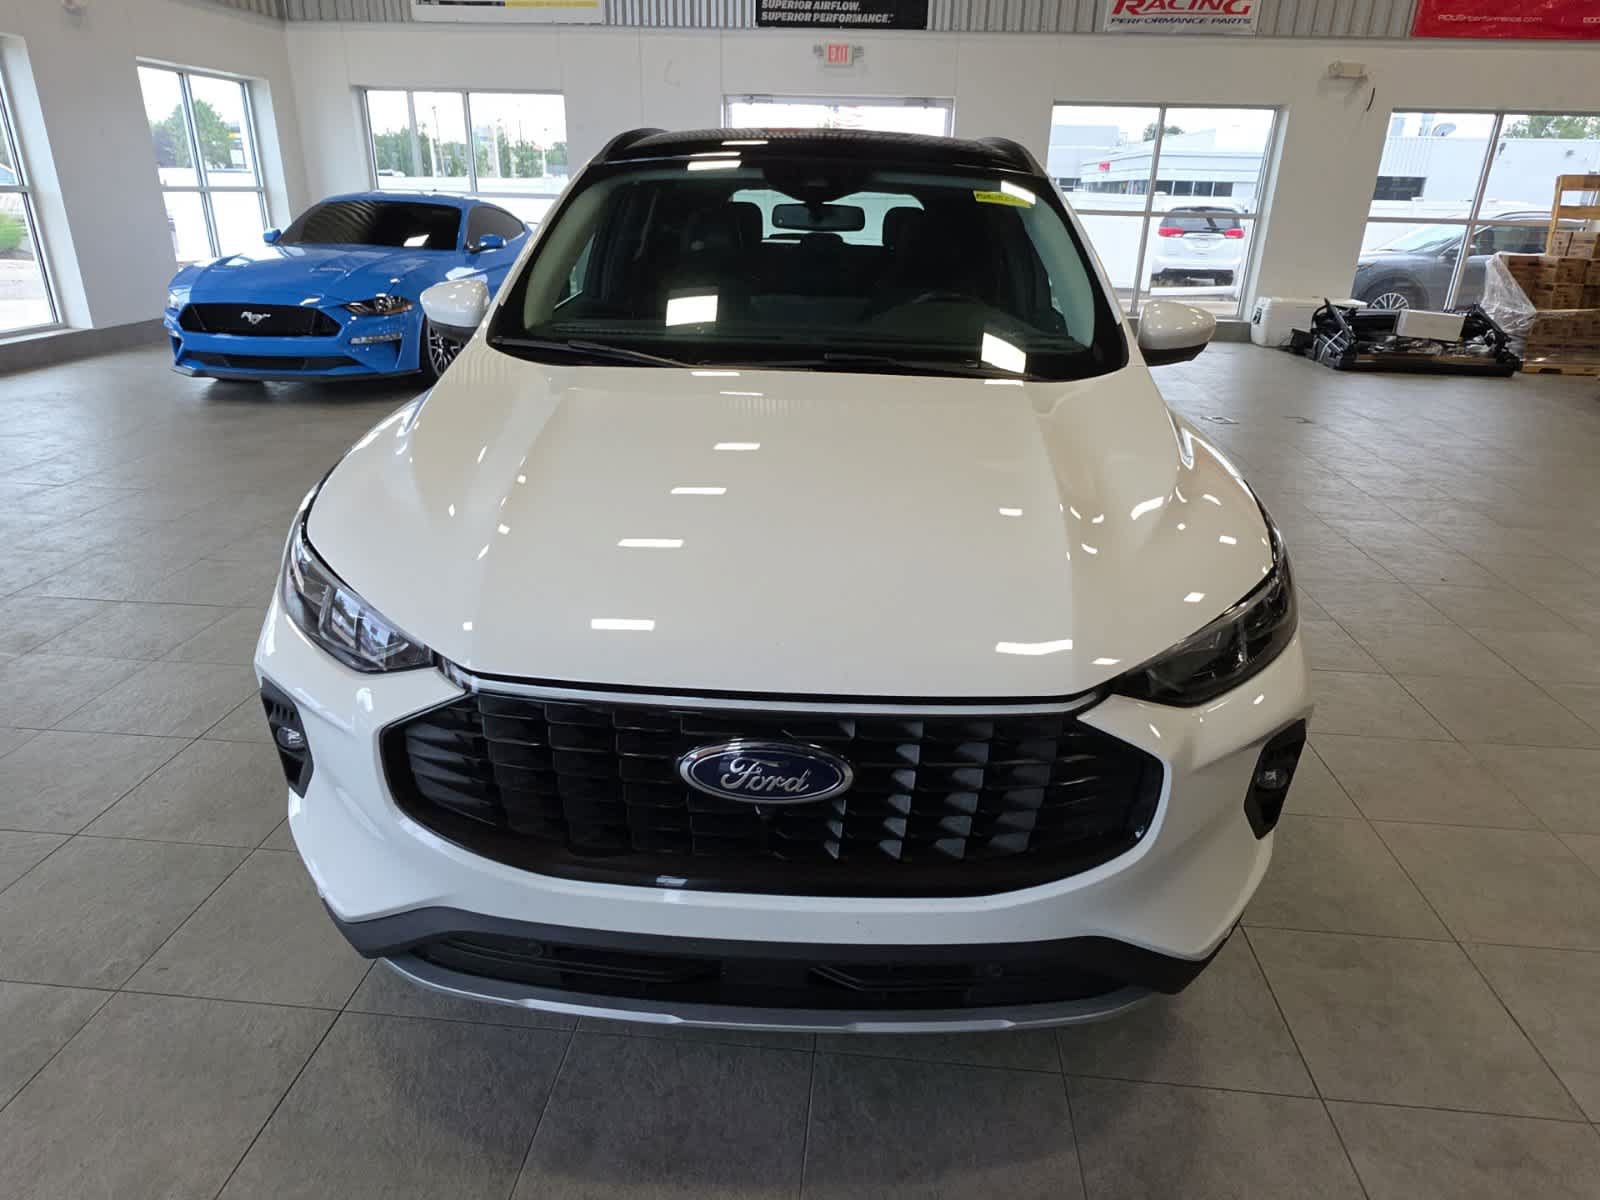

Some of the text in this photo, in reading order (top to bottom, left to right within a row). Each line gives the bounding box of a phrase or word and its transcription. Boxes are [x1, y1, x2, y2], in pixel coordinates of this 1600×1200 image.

[761, 0, 813, 10] SUPERIOR
[1111, 0, 1251, 15] RACING
[761, 11, 812, 22] SUPERIOR
[1110, 16, 1252, 25] PERFORMANCE PARTS
[828, 44, 849, 64] EXIT
[720, 757, 812, 793] Ford
